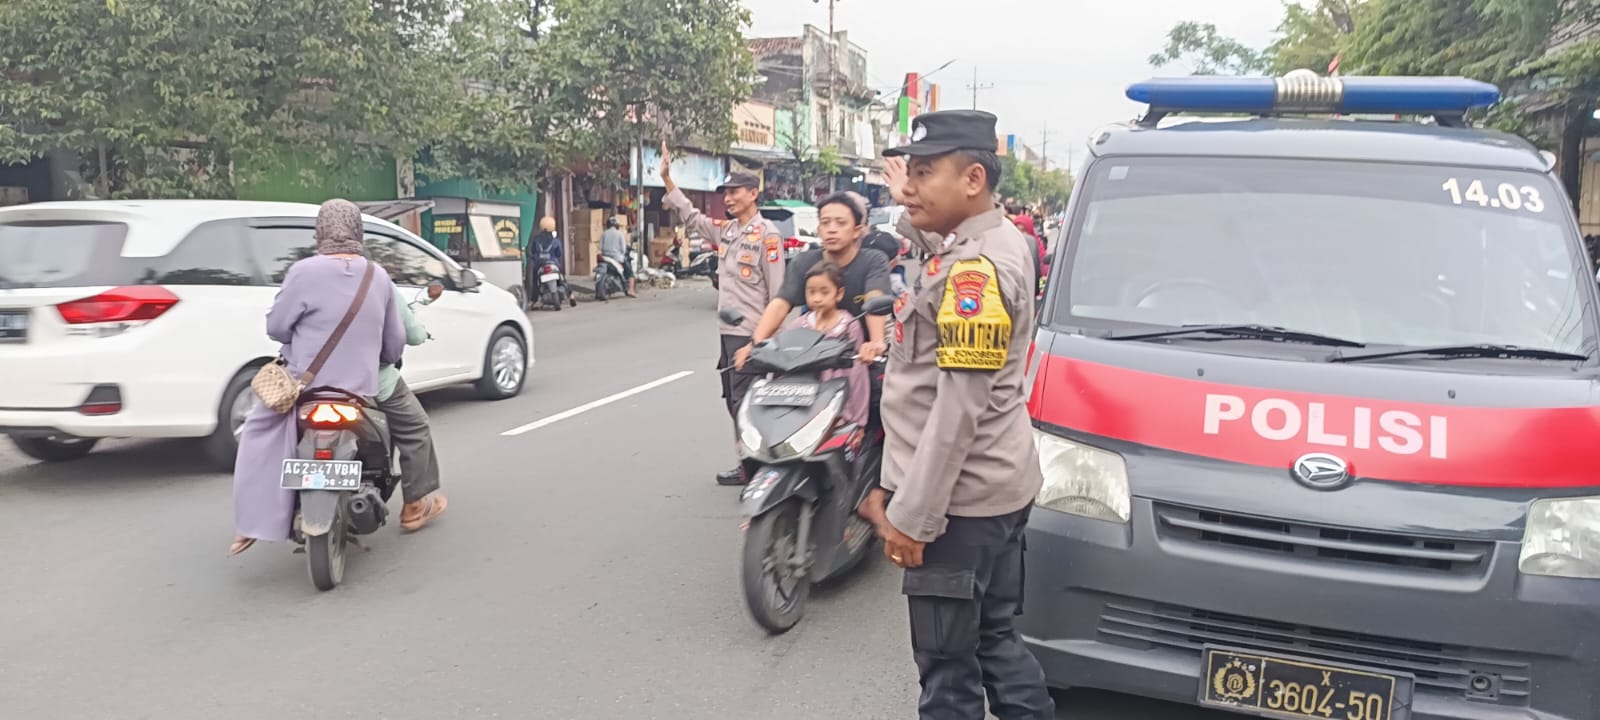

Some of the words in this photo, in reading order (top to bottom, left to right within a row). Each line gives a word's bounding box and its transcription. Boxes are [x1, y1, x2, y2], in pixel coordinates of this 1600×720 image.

[1441, 177, 1545, 213] 14.03
[1203, 393, 1447, 459] POLISI
[1321, 671, 1331, 686] X
[1266, 679, 1383, 720] 3604-50
